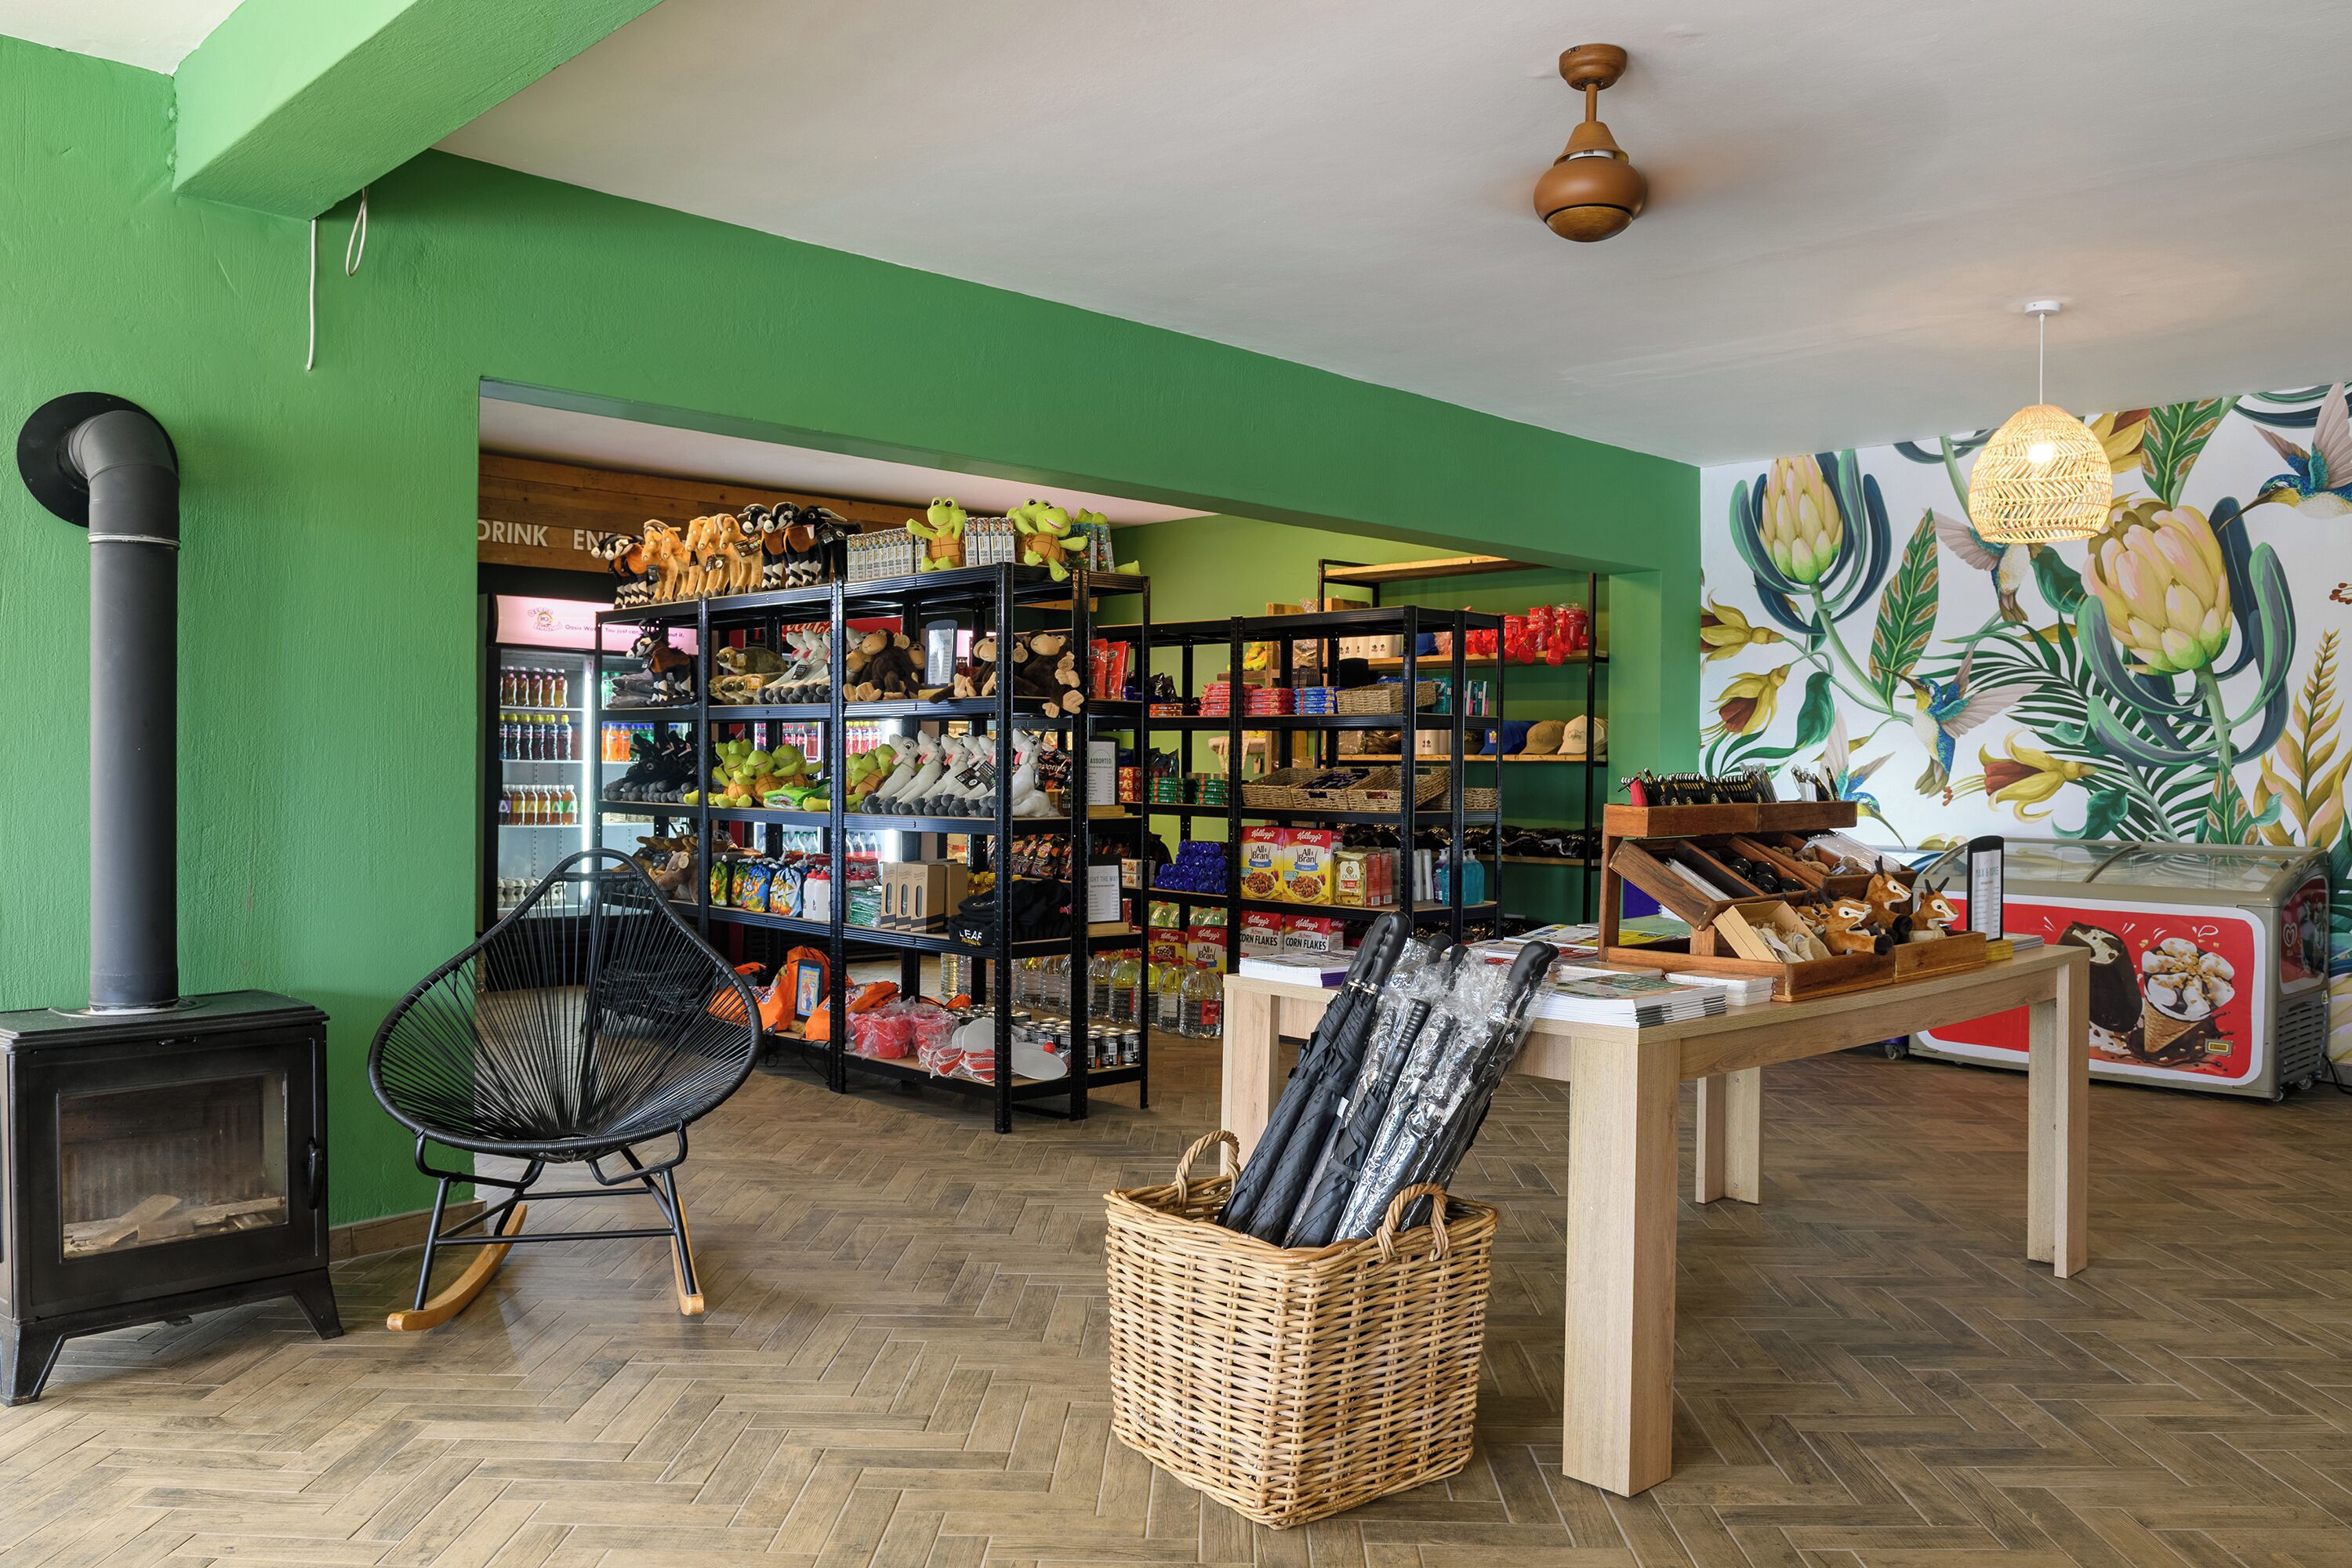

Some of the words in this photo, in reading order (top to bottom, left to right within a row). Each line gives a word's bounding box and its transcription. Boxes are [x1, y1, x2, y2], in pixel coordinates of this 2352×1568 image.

[477, 518, 549, 548] DRINK
[1250, 828, 1276, 840] Kellogg's
[1297, 831, 1323, 843] Kellogg's
[1252, 851, 1269, 859] Bran
[1298, 854, 1315, 862] Bran
[1247, 915, 1270, 927] Kellogg's
[1295, 918, 1319, 931] Kellogg's
[1160, 932, 1178, 942] Kellogg's
[1197, 929, 1221, 941] Kellogg's
[1239, 933, 1254, 943] CORN
[1254, 935, 1278, 946] FLAKES
[1285, 937, 1302, 948] CORN
[1303, 938, 1327, 950] FLAKES
[1199, 951, 1214, 960] Bran
